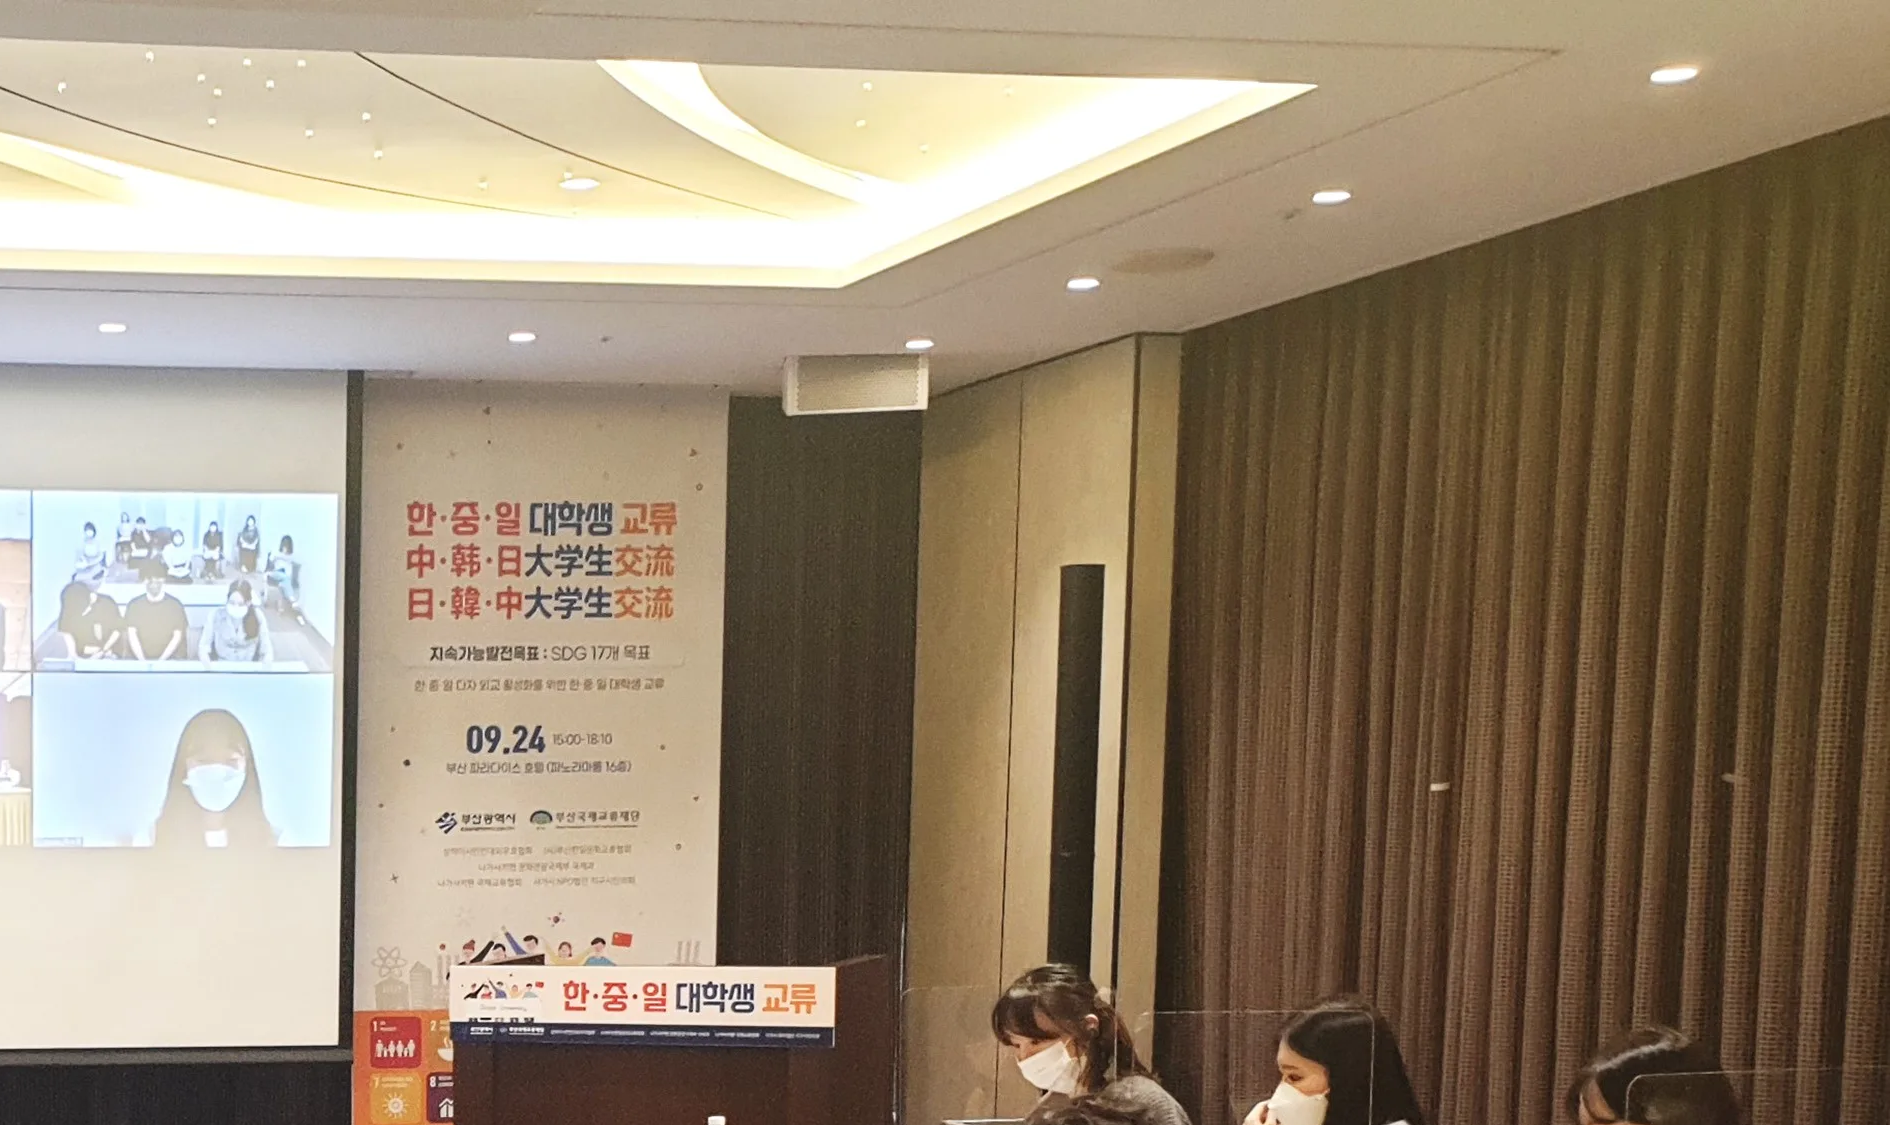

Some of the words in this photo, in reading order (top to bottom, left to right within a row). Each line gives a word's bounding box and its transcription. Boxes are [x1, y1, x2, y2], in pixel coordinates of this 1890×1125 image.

[407, 500, 521, 537] 한·중·일
[529, 500, 614, 537] 대학생
[620, 501, 678, 537] 교류
[429, 645, 540, 662] 지속가능발전목표
[551, 646, 588, 662] SDG
[591, 646, 620, 661] 17개
[623, 645, 650, 661] 목표
[465, 724, 547, 755] 09.24
[446, 762, 467, 775] 부산
[470, 761, 521, 774] 파라다이스
[461, 812, 517, 826] 부산광역시
[556, 810, 641, 823] 부산국제교류재단
[562, 979, 668, 1012] 한·중·일
[675, 980, 755, 1014] 대학생
[762, 983, 818, 1015] 교류
[372, 1021, 378, 1032] 1
[430, 1020, 437, 1031] 2
[429, 1076, 437, 1088] 8
